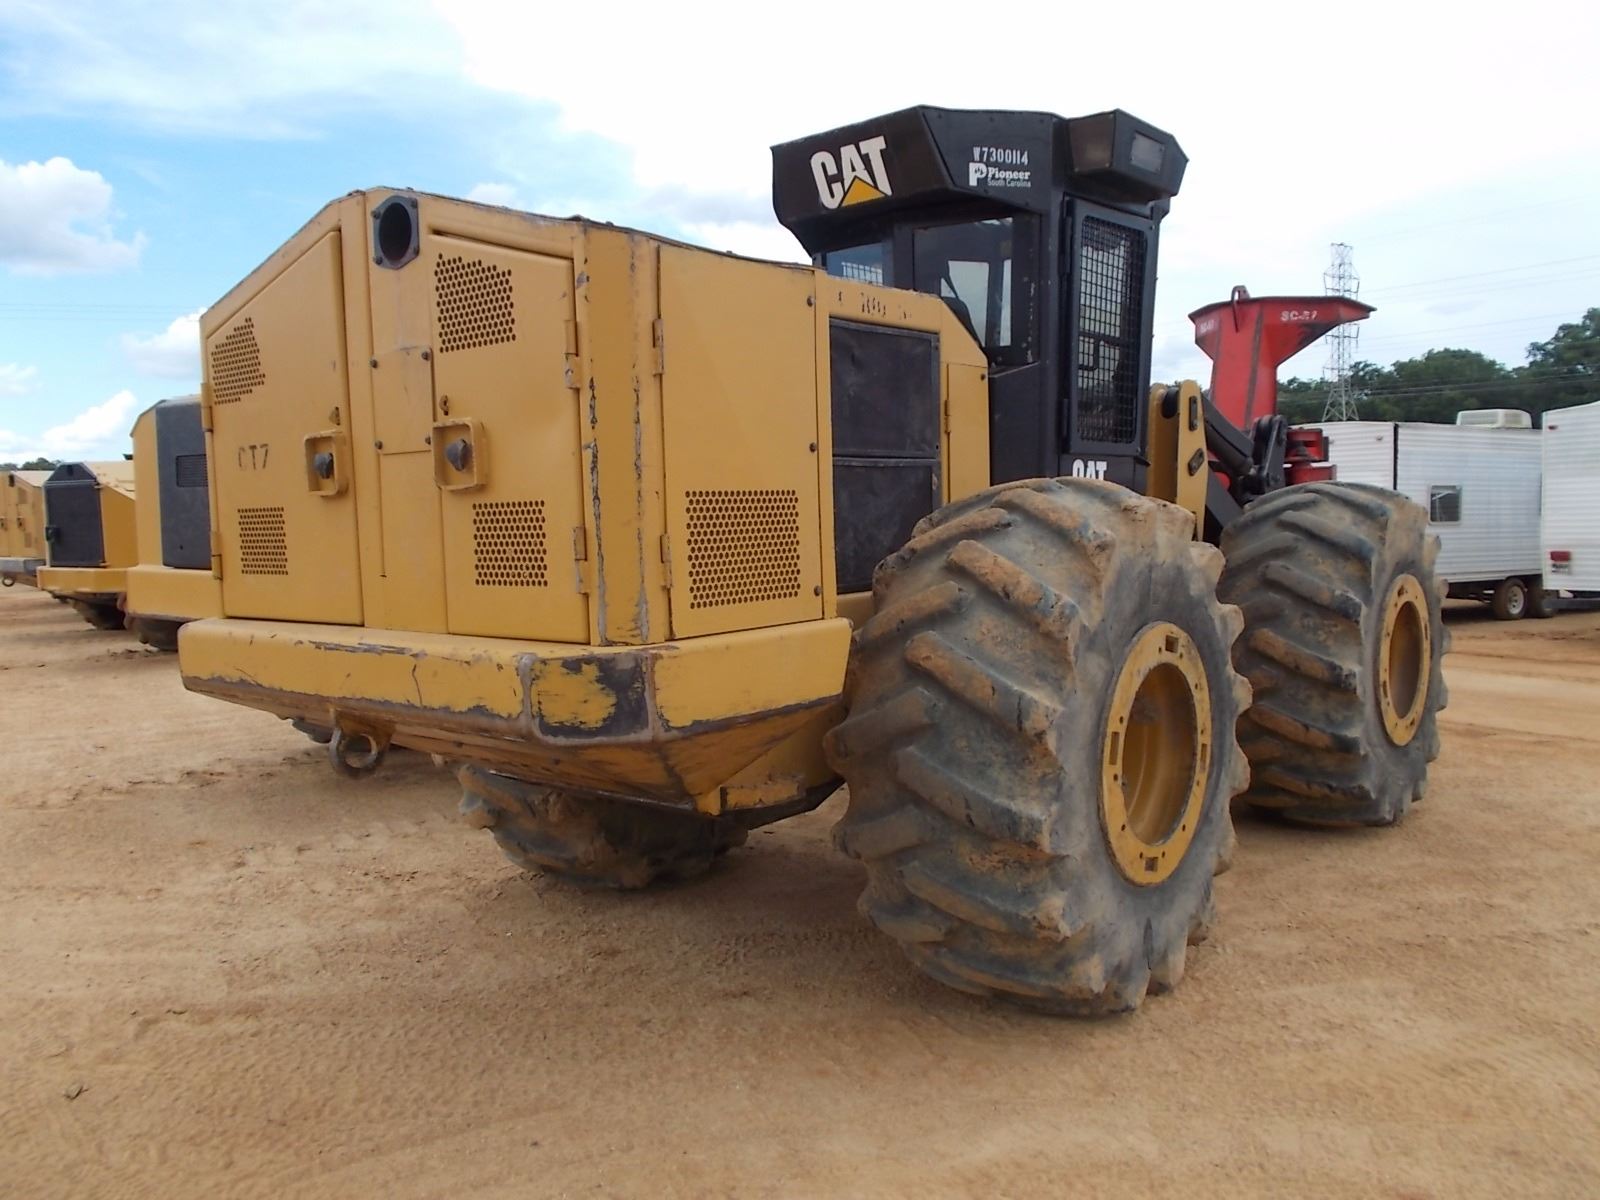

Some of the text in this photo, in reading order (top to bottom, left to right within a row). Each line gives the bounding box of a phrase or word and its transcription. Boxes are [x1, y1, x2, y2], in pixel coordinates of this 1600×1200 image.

[810, 135, 893, 210] CAT
[987, 166, 1031, 180] Pioneer
[987, 177, 1032, 188] South Carolina
